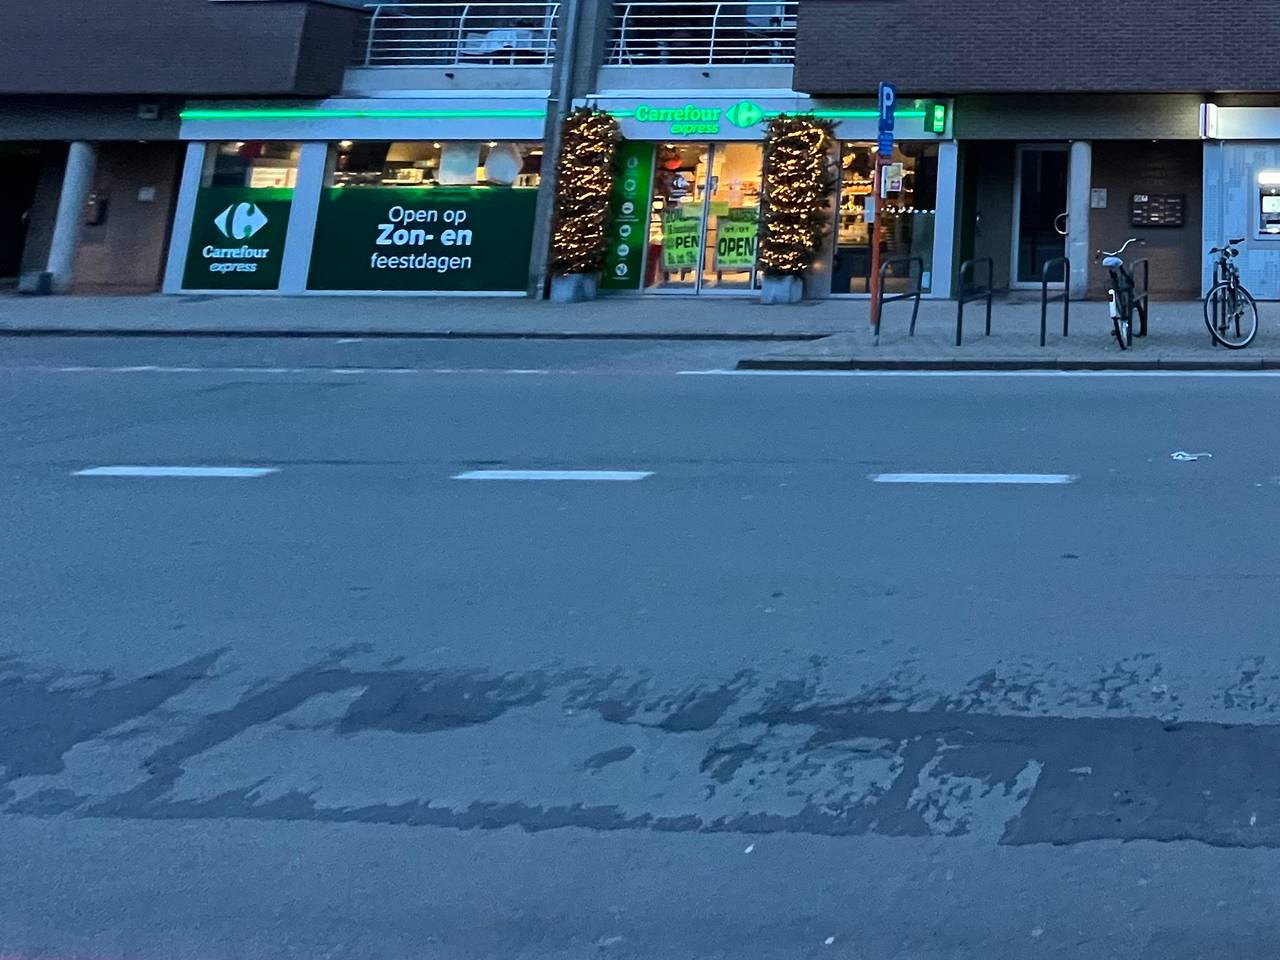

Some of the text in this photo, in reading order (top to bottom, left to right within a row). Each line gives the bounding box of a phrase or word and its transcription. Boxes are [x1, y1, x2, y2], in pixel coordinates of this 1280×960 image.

[883, 86, 894, 119] P
[635, 104, 721, 122] Carrefour
[671, 123, 719, 137] express
[388, 206, 467, 225] Open op
[376, 224, 473, 246] Zon- en
[202, 245, 270, 258] Carrefour
[718, 237, 755, 257] OPEN
[209, 262, 258, 274] express
[370, 252, 472, 273] feestdagen
